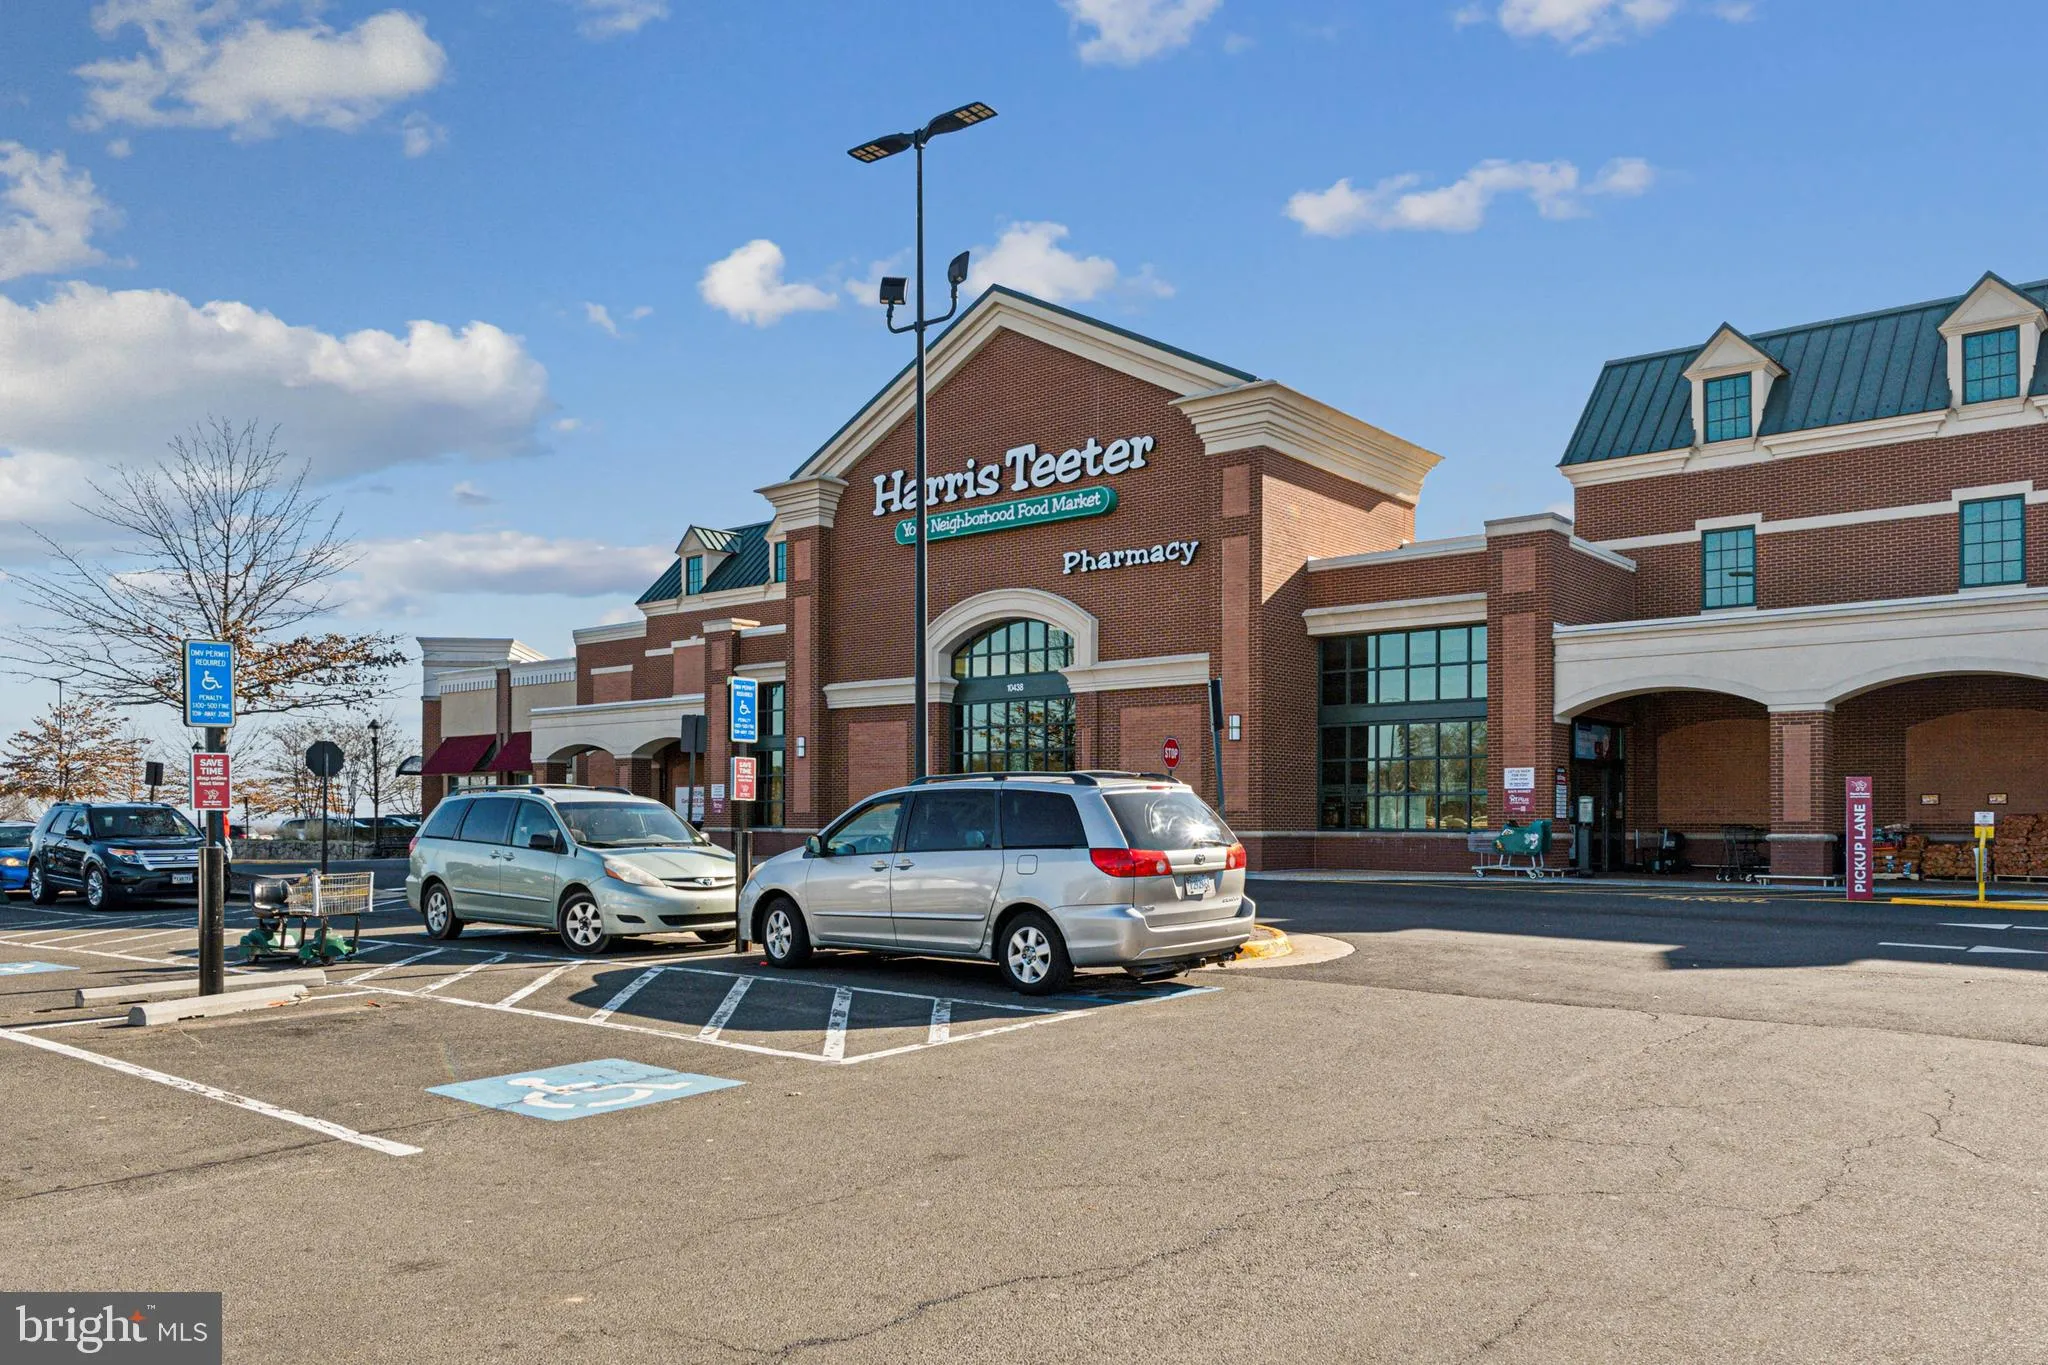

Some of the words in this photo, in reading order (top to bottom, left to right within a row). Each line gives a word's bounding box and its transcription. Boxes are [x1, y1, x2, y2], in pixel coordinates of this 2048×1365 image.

[872, 458, 1000, 516] Harris
[1005, 435, 1154, 492] Teeter
[902, 522, 928, 537] Yo
[930, 504, 1015, 534] Neighborhood
[1017, 498, 1049, 519] Food
[1051, 491, 1101, 513] Market
[1062, 540, 1199, 575] Pharmacy
[190, 649, 204, 657] DMV
[205, 649, 229, 658] PERMIT
[195, 659, 226, 667] REQUIRED
[1007, 683, 1024, 692] 10438
[1164, 747, 1178, 759] STOP
[199, 758, 224, 767] SAVE
[200, 767, 224, 775] TIME
[1853, 804, 1867, 840] LANE
[1854, 842, 1867, 893] PICKUP
